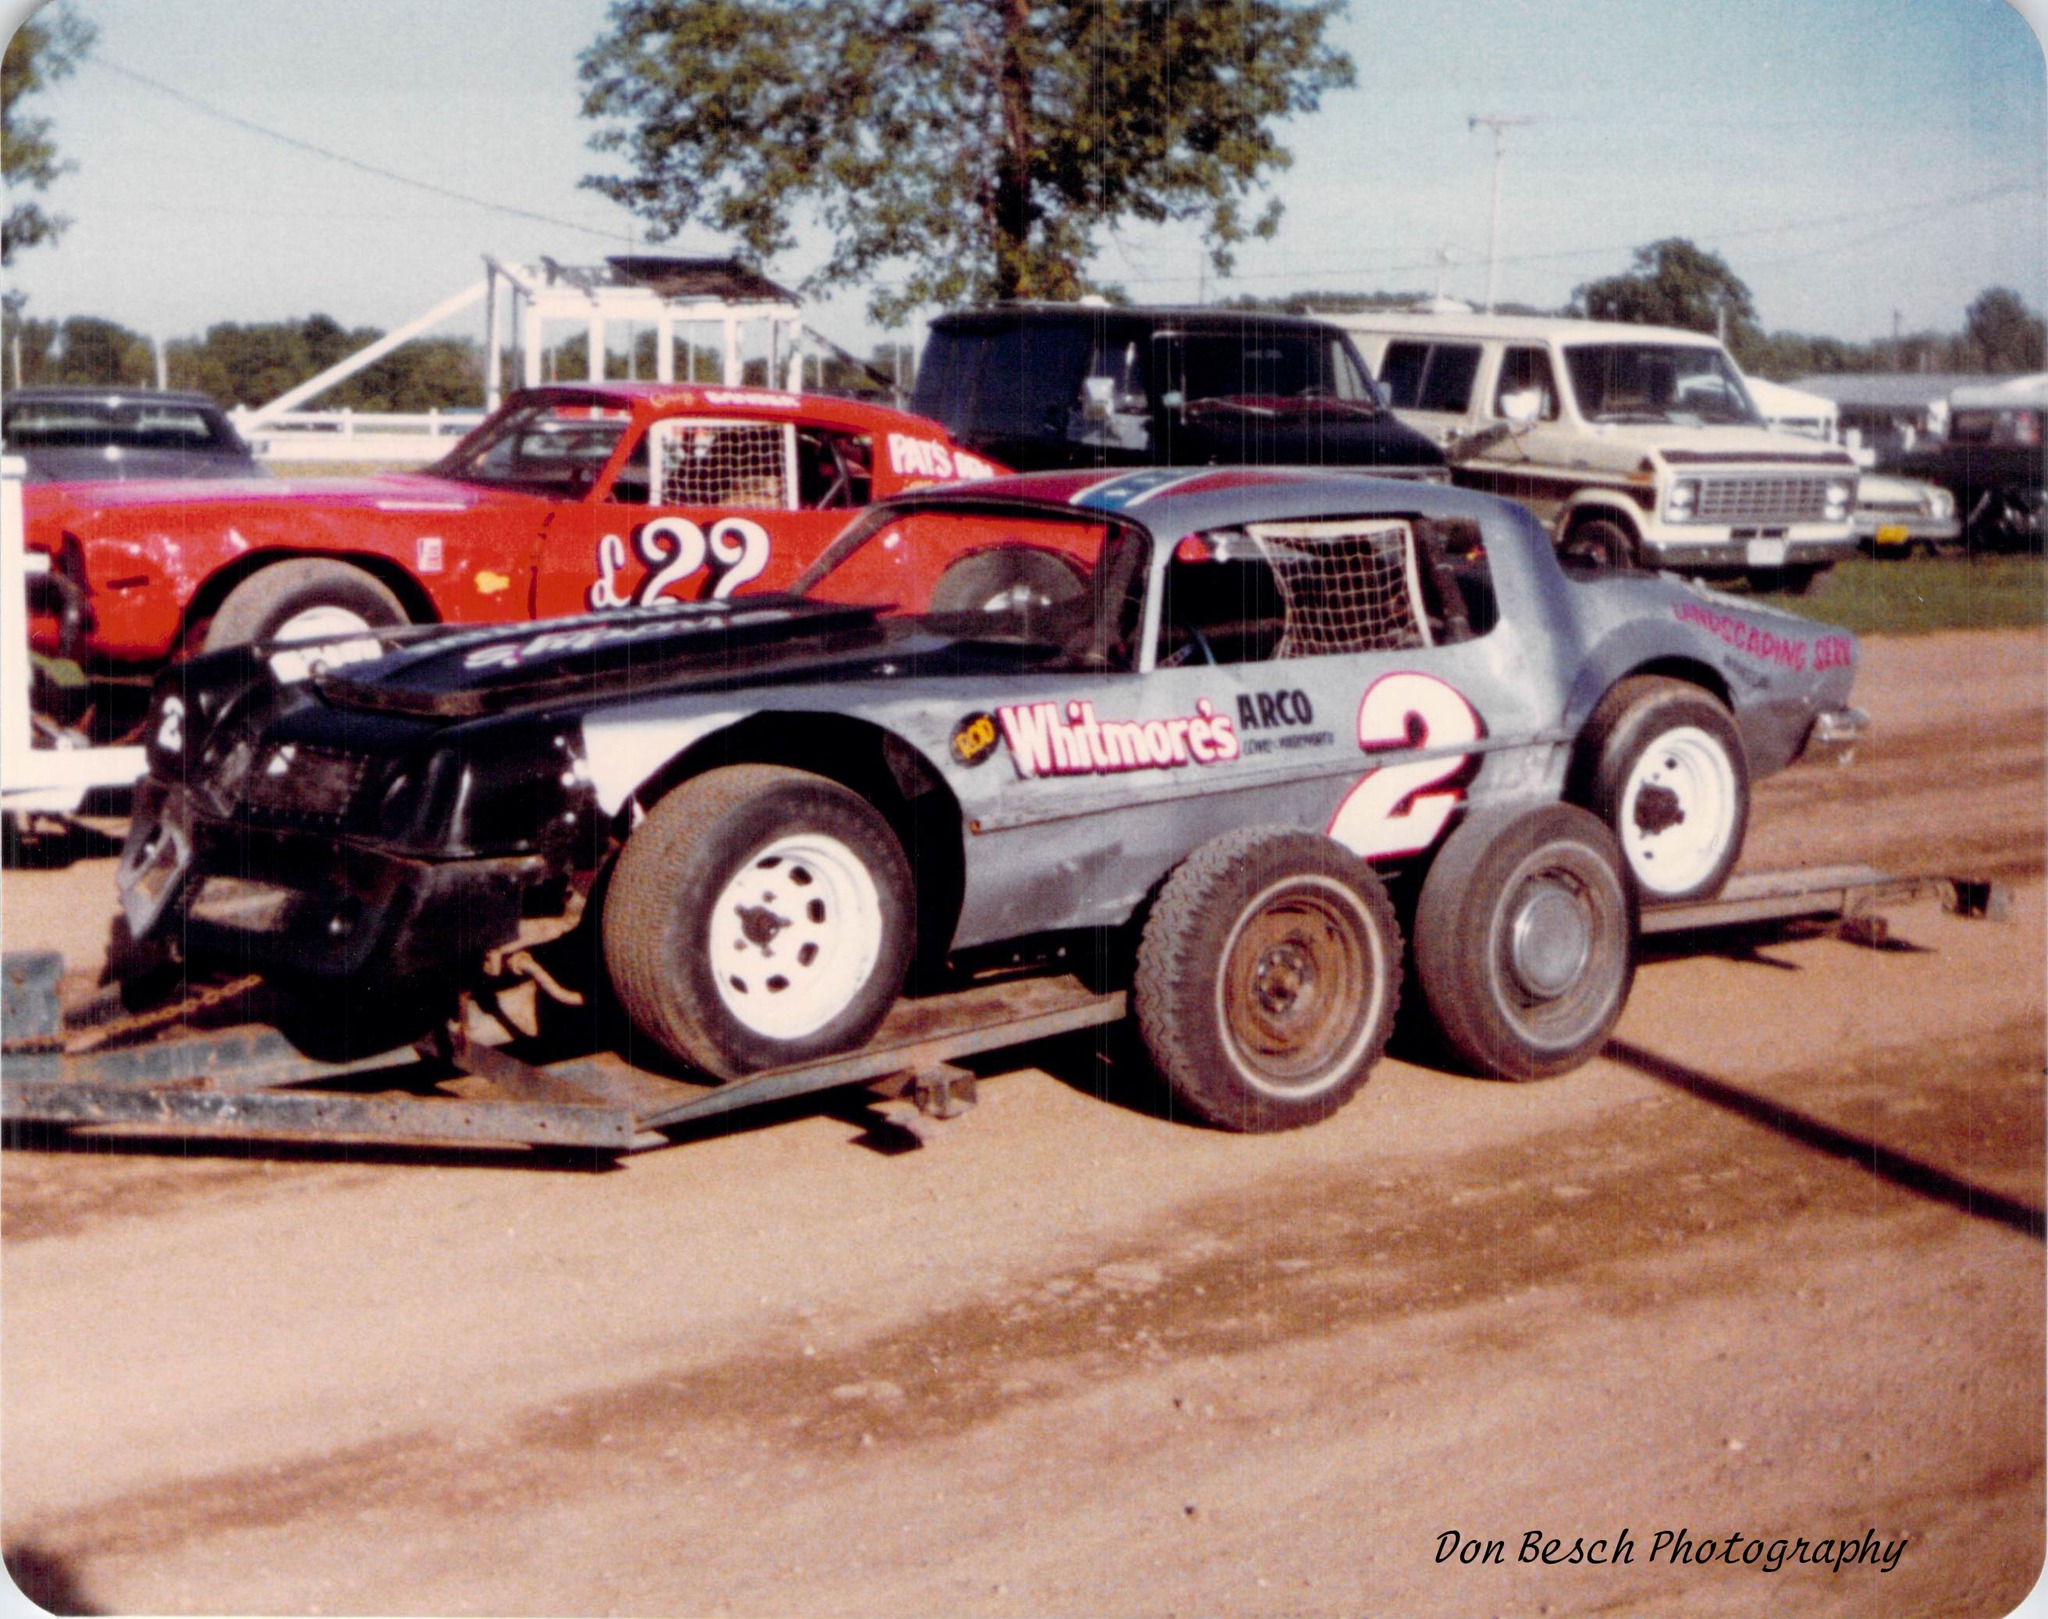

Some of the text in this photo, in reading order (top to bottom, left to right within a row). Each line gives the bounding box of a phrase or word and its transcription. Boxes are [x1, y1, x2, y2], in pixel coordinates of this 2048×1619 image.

[998, 698, 1239, 778] Whitmore's
[1236, 688, 1313, 730] ARCO
[1325, 670, 1485, 866] 2
